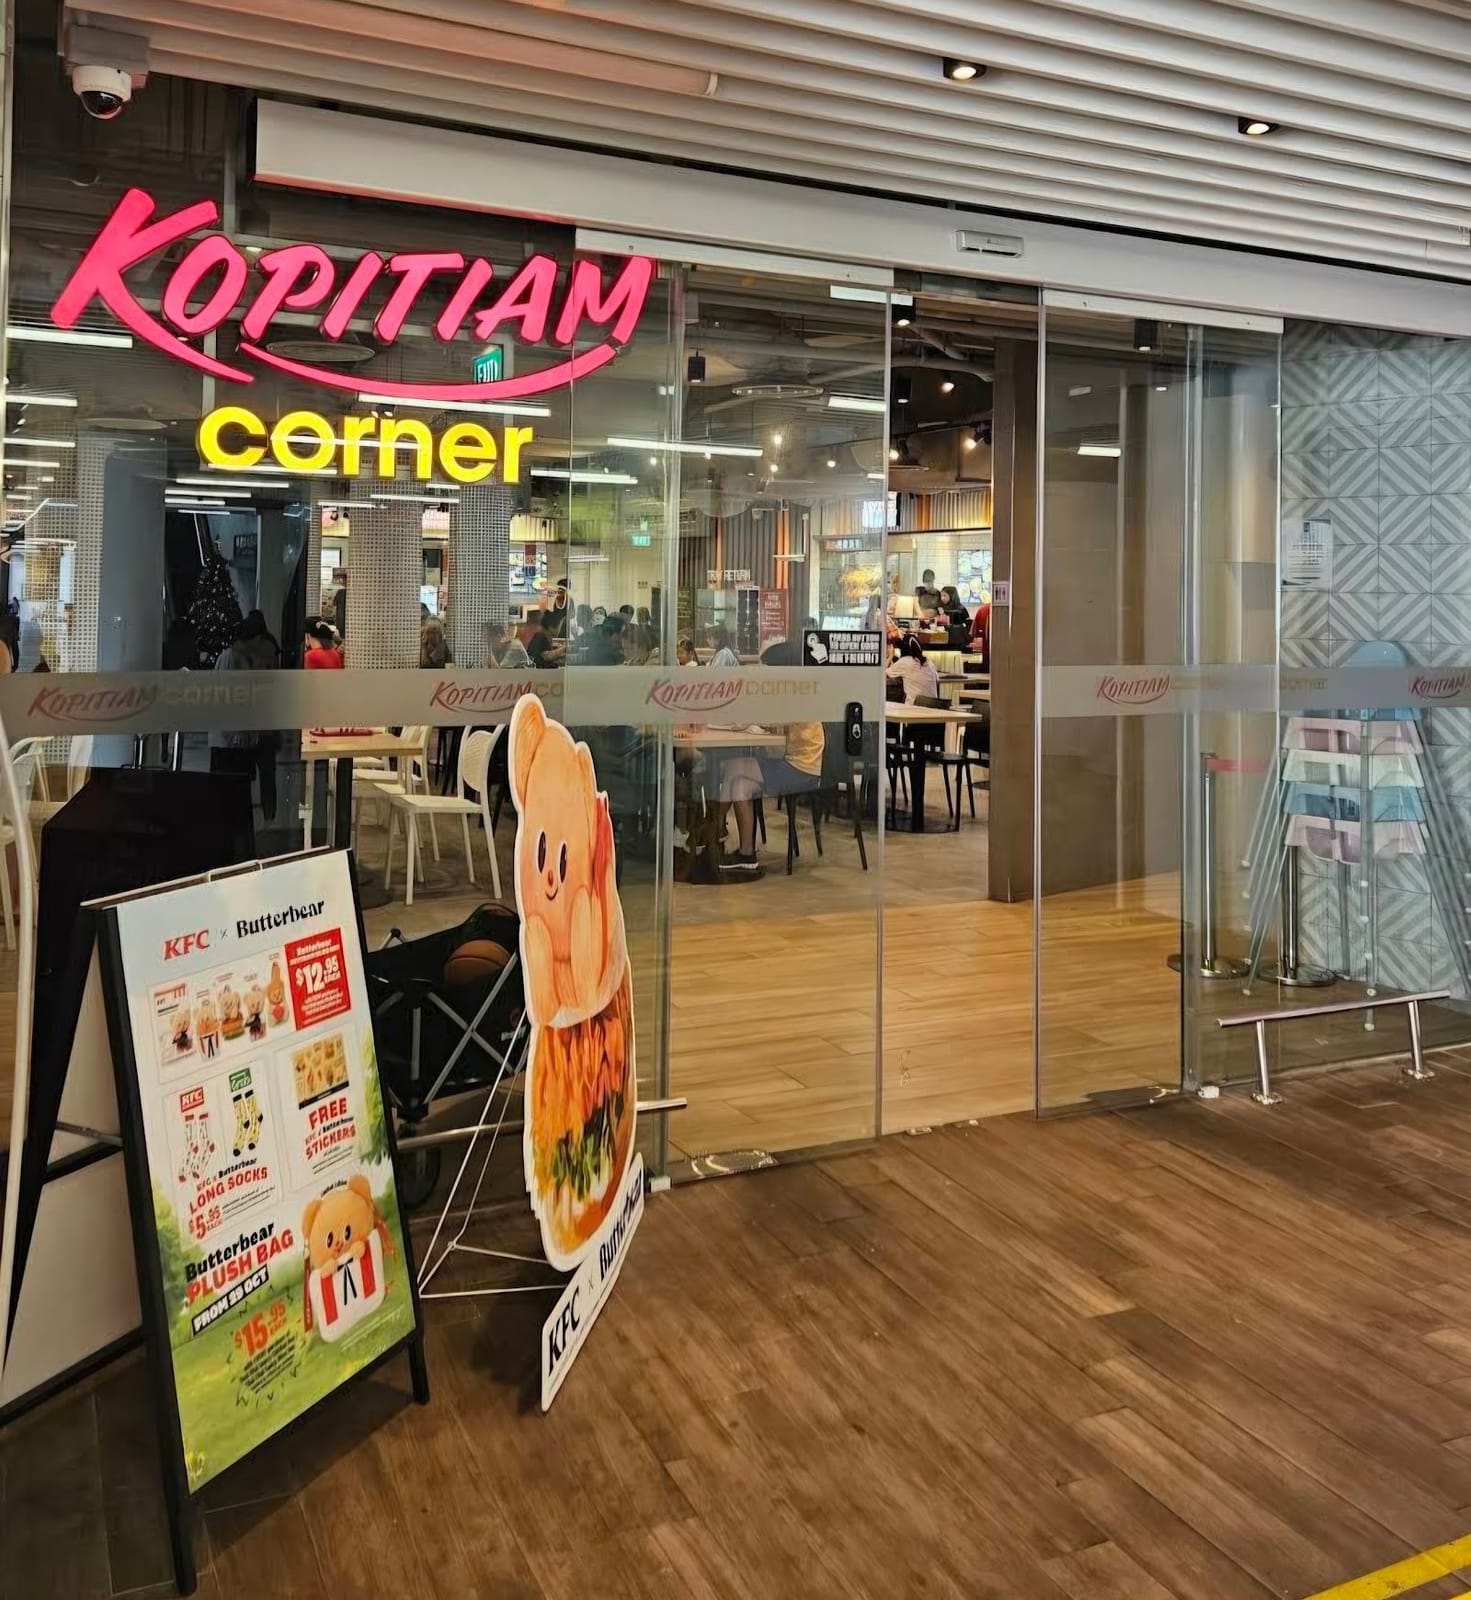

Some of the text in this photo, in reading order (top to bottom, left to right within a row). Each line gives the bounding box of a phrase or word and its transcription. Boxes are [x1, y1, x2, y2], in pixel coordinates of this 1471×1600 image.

[51, 188, 655, 392] KOPITIAM
[197, 406, 535, 484] corner
[27, 687, 157, 722] KOPITIAM
[429, 680, 533, 713] KOPITIAM
[645, 678, 744, 712] KOPITIAM
[163, 929, 211, 961] KFC
[236, 900, 325, 939] Butterbear
[306, 1124, 357, 1161] STICKERS
[308, 1097, 348, 1131] FREE
[189, 1181, 226, 1215] LONG
[227, 1166, 268, 1191] SOCKS
[185, 1222, 275, 1283] Butterbear
[186, 1228, 294, 1306] PLUSH BAG
[193, 1296, 230, 1333] FROM
[243, 1267, 269, 1294] OCT
[548, 1285, 581, 1377] KFC
